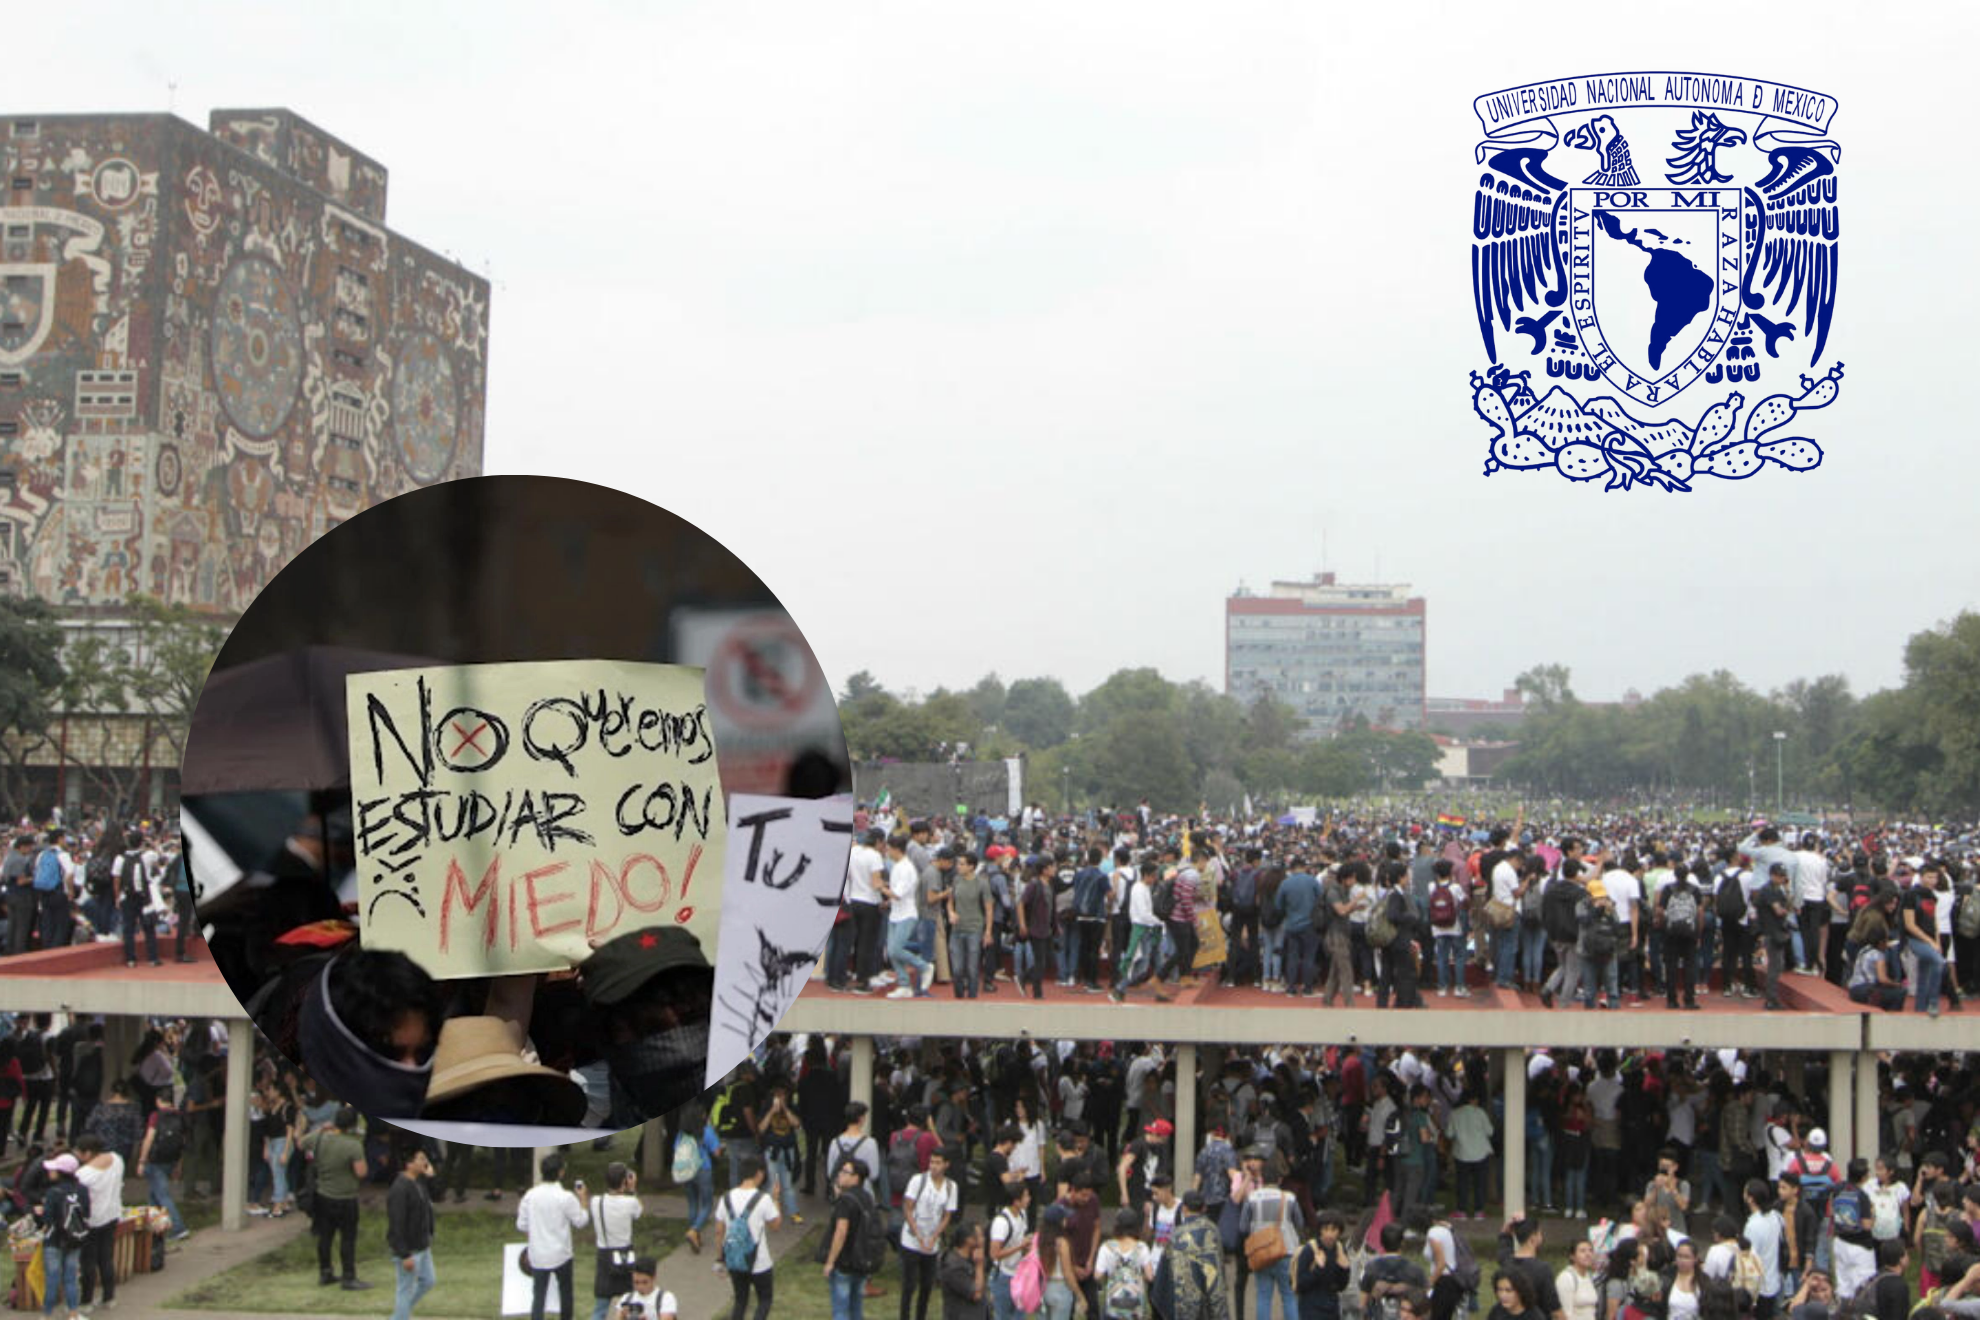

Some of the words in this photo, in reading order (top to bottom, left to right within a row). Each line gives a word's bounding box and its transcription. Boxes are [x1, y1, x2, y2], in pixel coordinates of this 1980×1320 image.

[366, 675, 510, 788] NO
[357, 785, 597, 857] ESTUDIAR
[615, 780, 714, 843] CON
[438, 844, 703, 957] MIEDO!
